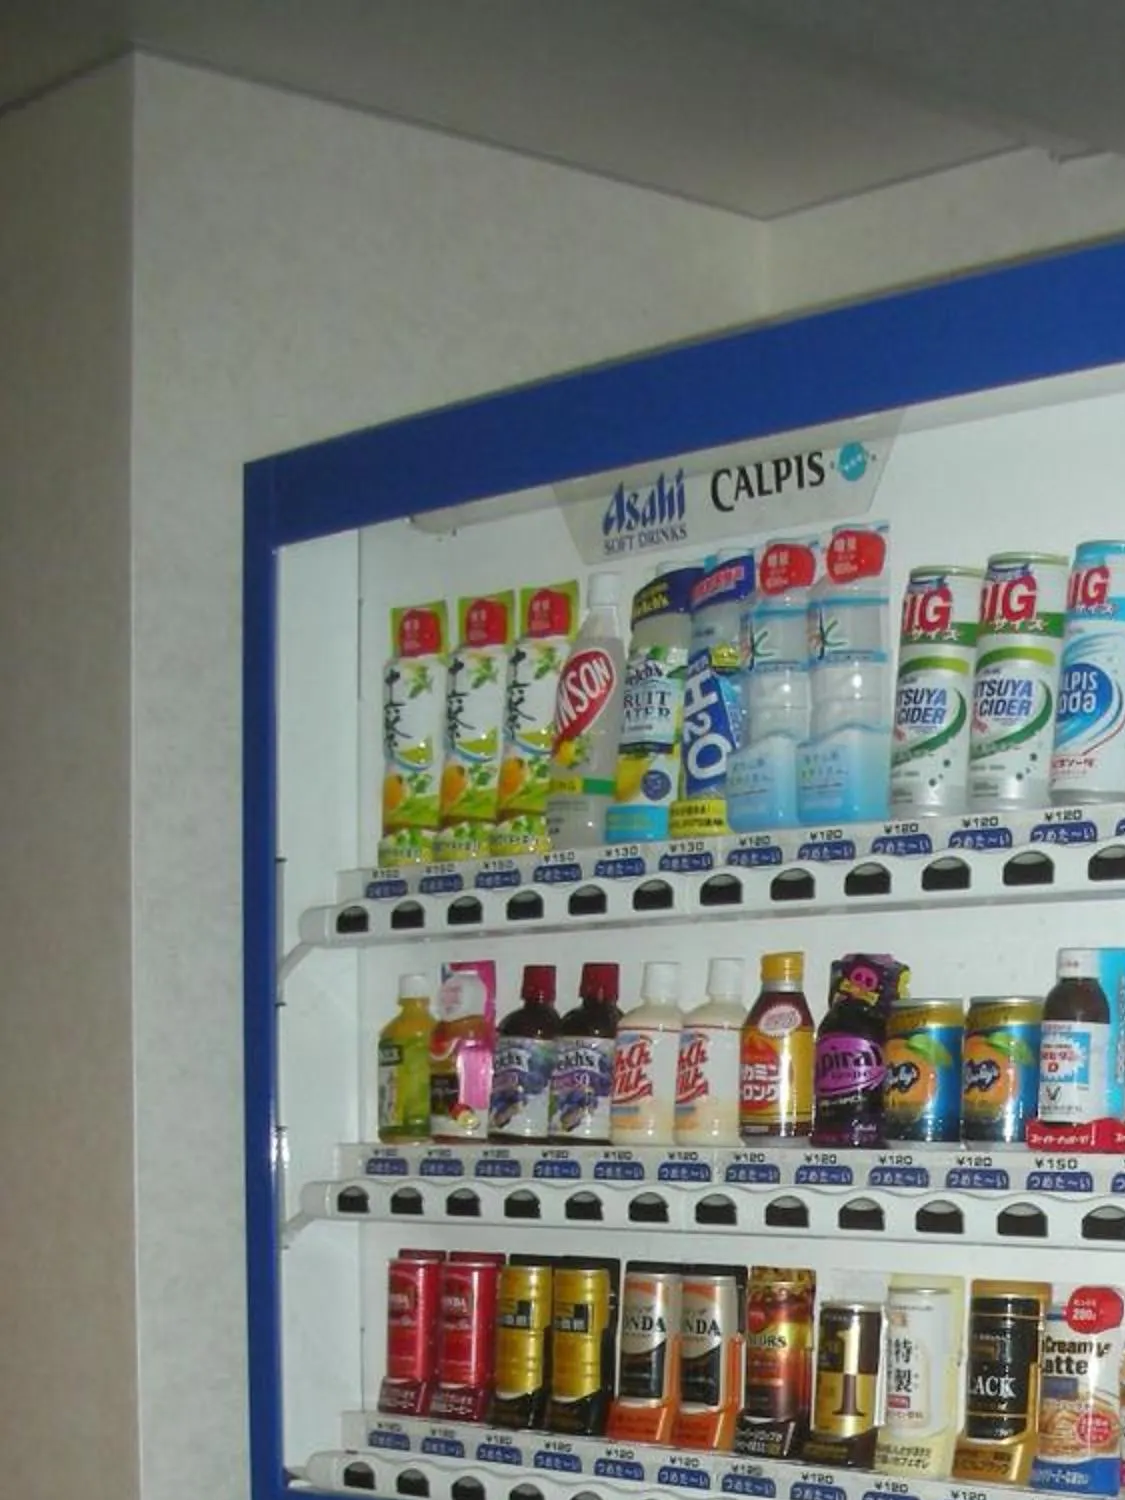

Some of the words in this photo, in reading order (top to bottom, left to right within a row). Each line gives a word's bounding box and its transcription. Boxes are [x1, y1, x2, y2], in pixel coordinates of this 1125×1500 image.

[710, 450, 825, 513] CALPIS
[602, 468, 686, 536] Asahi
[604, 535, 635, 555] SOFT
[638, 525, 688, 550] DRINKS
[979, 698, 1032, 717] CIDER
[962, 815, 999, 828] ¥120
[1045, 809, 1082, 821] ¥120
[957, 1156, 993, 1167] ¥120
[1035, 1157, 1078, 1170] ¥150
[1041, 1359, 1088, 1376] atte
[969, 1375, 1017, 1398] ACK
